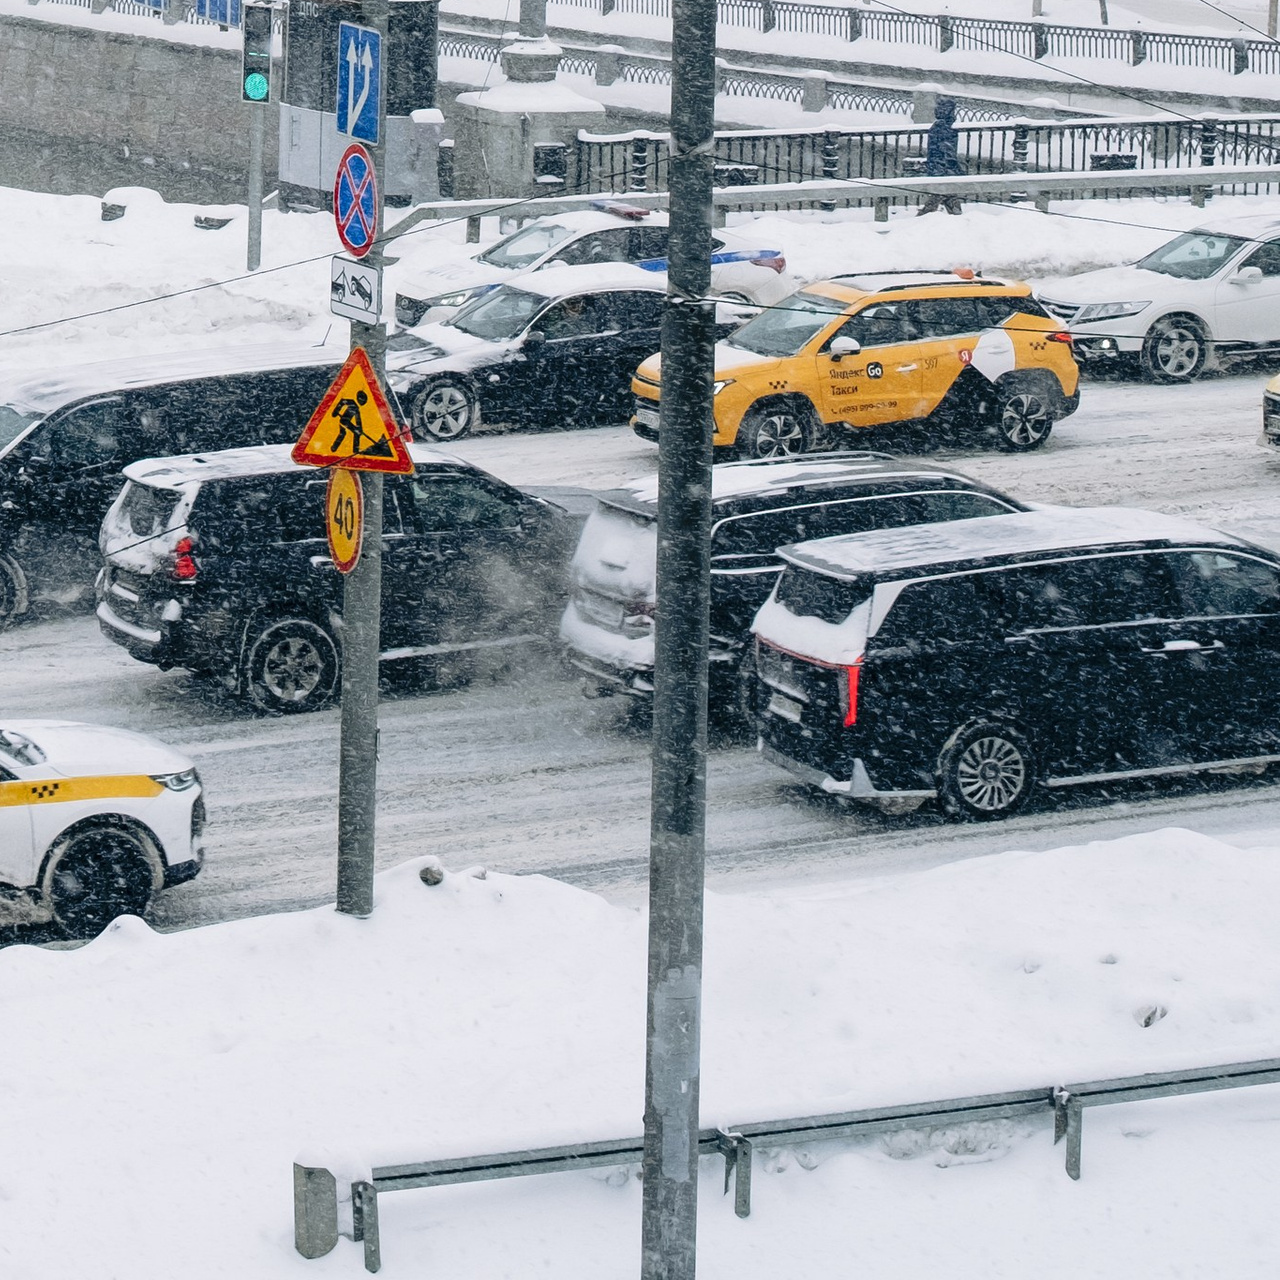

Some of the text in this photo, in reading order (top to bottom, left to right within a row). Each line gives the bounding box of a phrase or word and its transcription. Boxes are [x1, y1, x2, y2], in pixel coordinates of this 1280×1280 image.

[299, 1, 319, 18] ДПС
[961, 350, 970, 362] Я
[830, 365, 882, 380] Яндекс Go
[830, 385, 858, 396] Такси
[334, 493, 354, 540] 40
